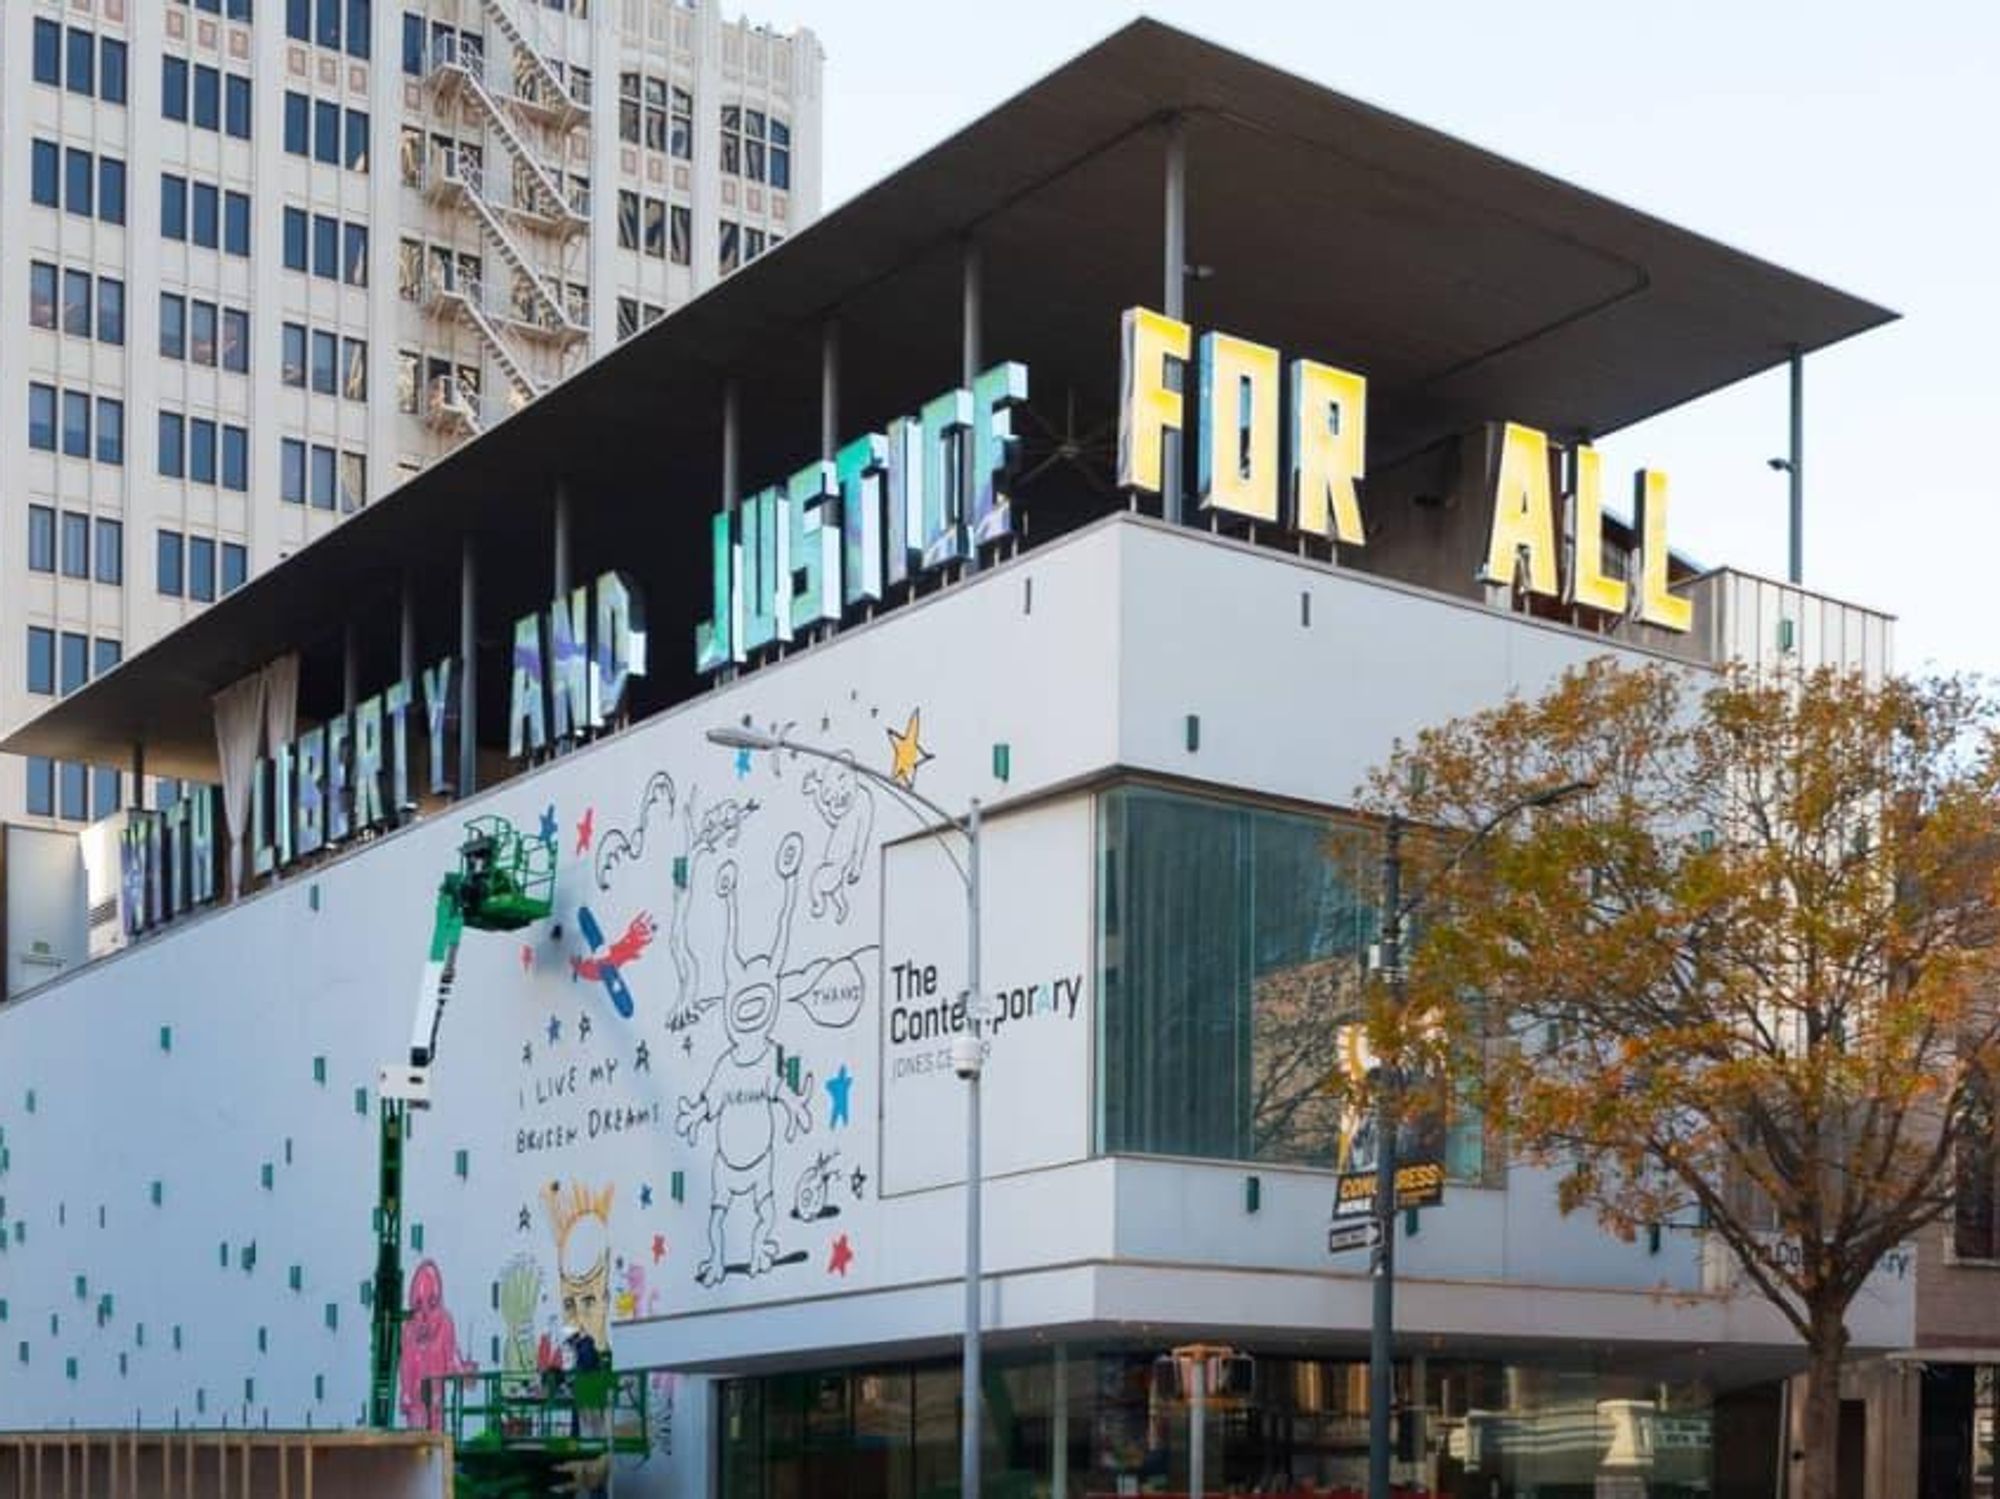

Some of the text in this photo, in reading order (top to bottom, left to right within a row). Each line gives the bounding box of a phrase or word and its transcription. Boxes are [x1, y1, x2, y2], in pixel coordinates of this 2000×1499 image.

[120, 306, 1692, 936] WITH LIBERTY AND JUSTICE FOR ALL
[891, 959, 937, 1001] The
[535, 1065, 577, 1104] LIVE
[590, 1057, 618, 1086] MY
